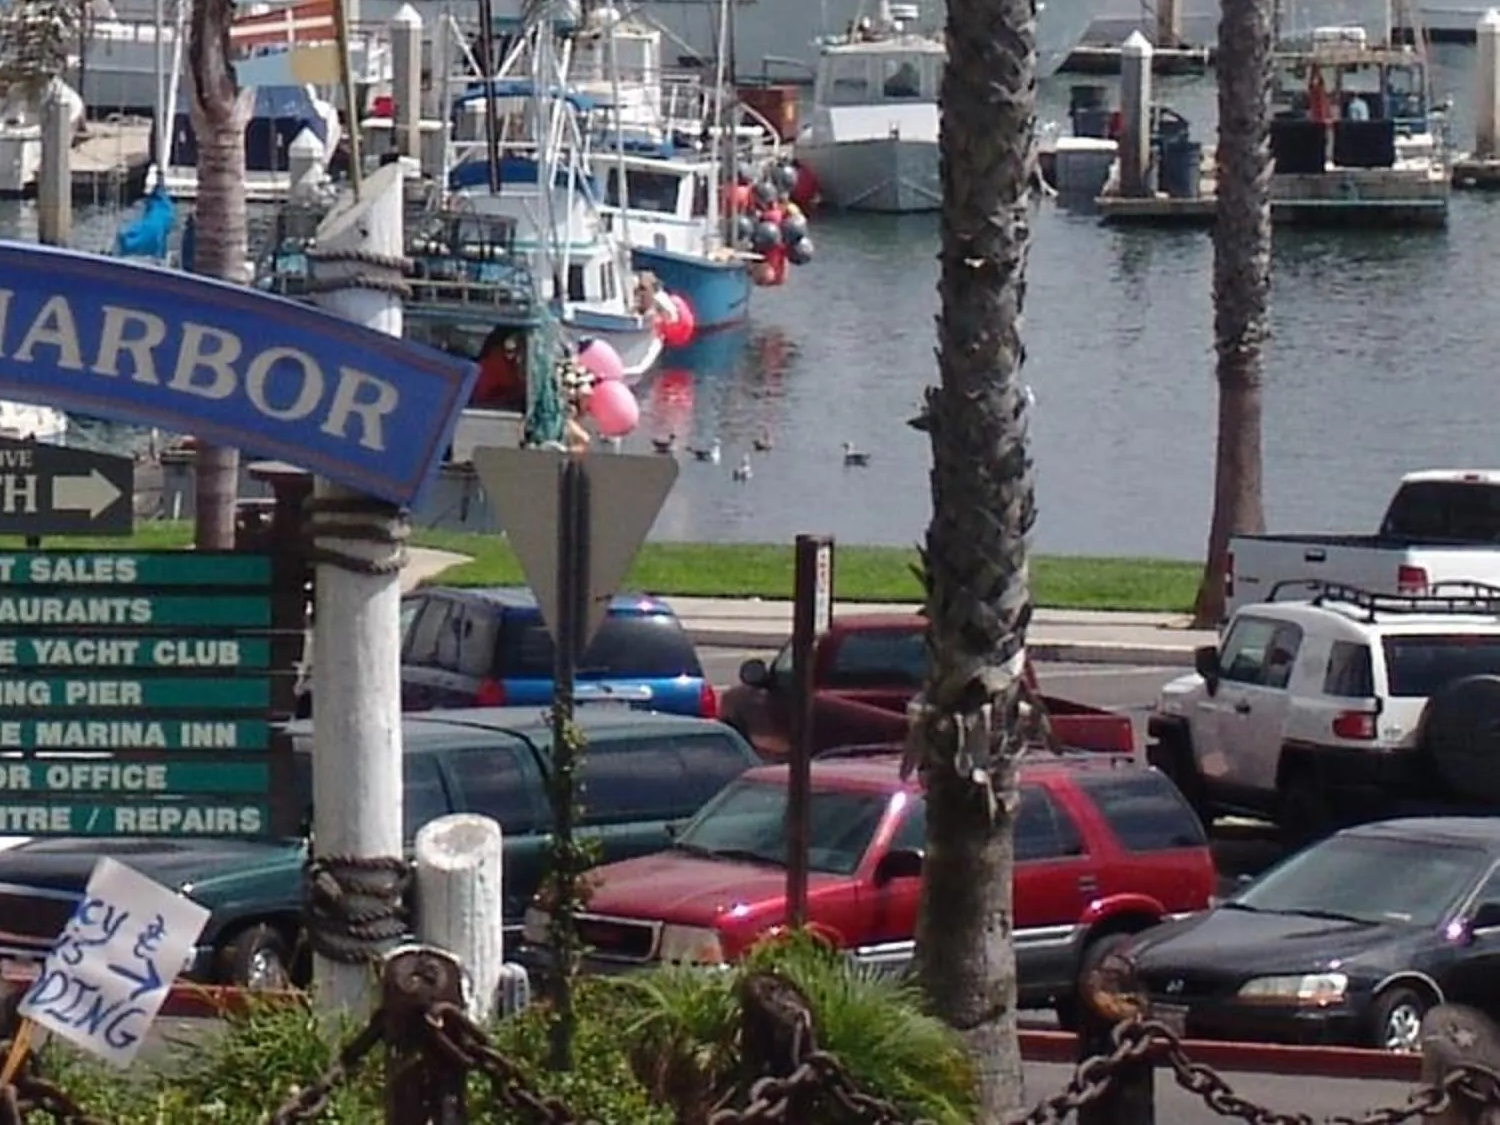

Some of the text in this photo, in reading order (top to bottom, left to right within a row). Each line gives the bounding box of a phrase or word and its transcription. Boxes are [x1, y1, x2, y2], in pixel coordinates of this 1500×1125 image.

[30, 556, 137, 583] SALES
[31, 638, 140, 665] YACHT
[153, 640, 240, 666] CLUB
[66, 680, 142, 706] PIER
[35, 721, 166, 748] MARINA
[181, 722, 237, 748] INN
[46, 764, 167, 790] OFFICE
[85, 806, 101, 832] /
[115, 806, 261, 833] REPAIRS
